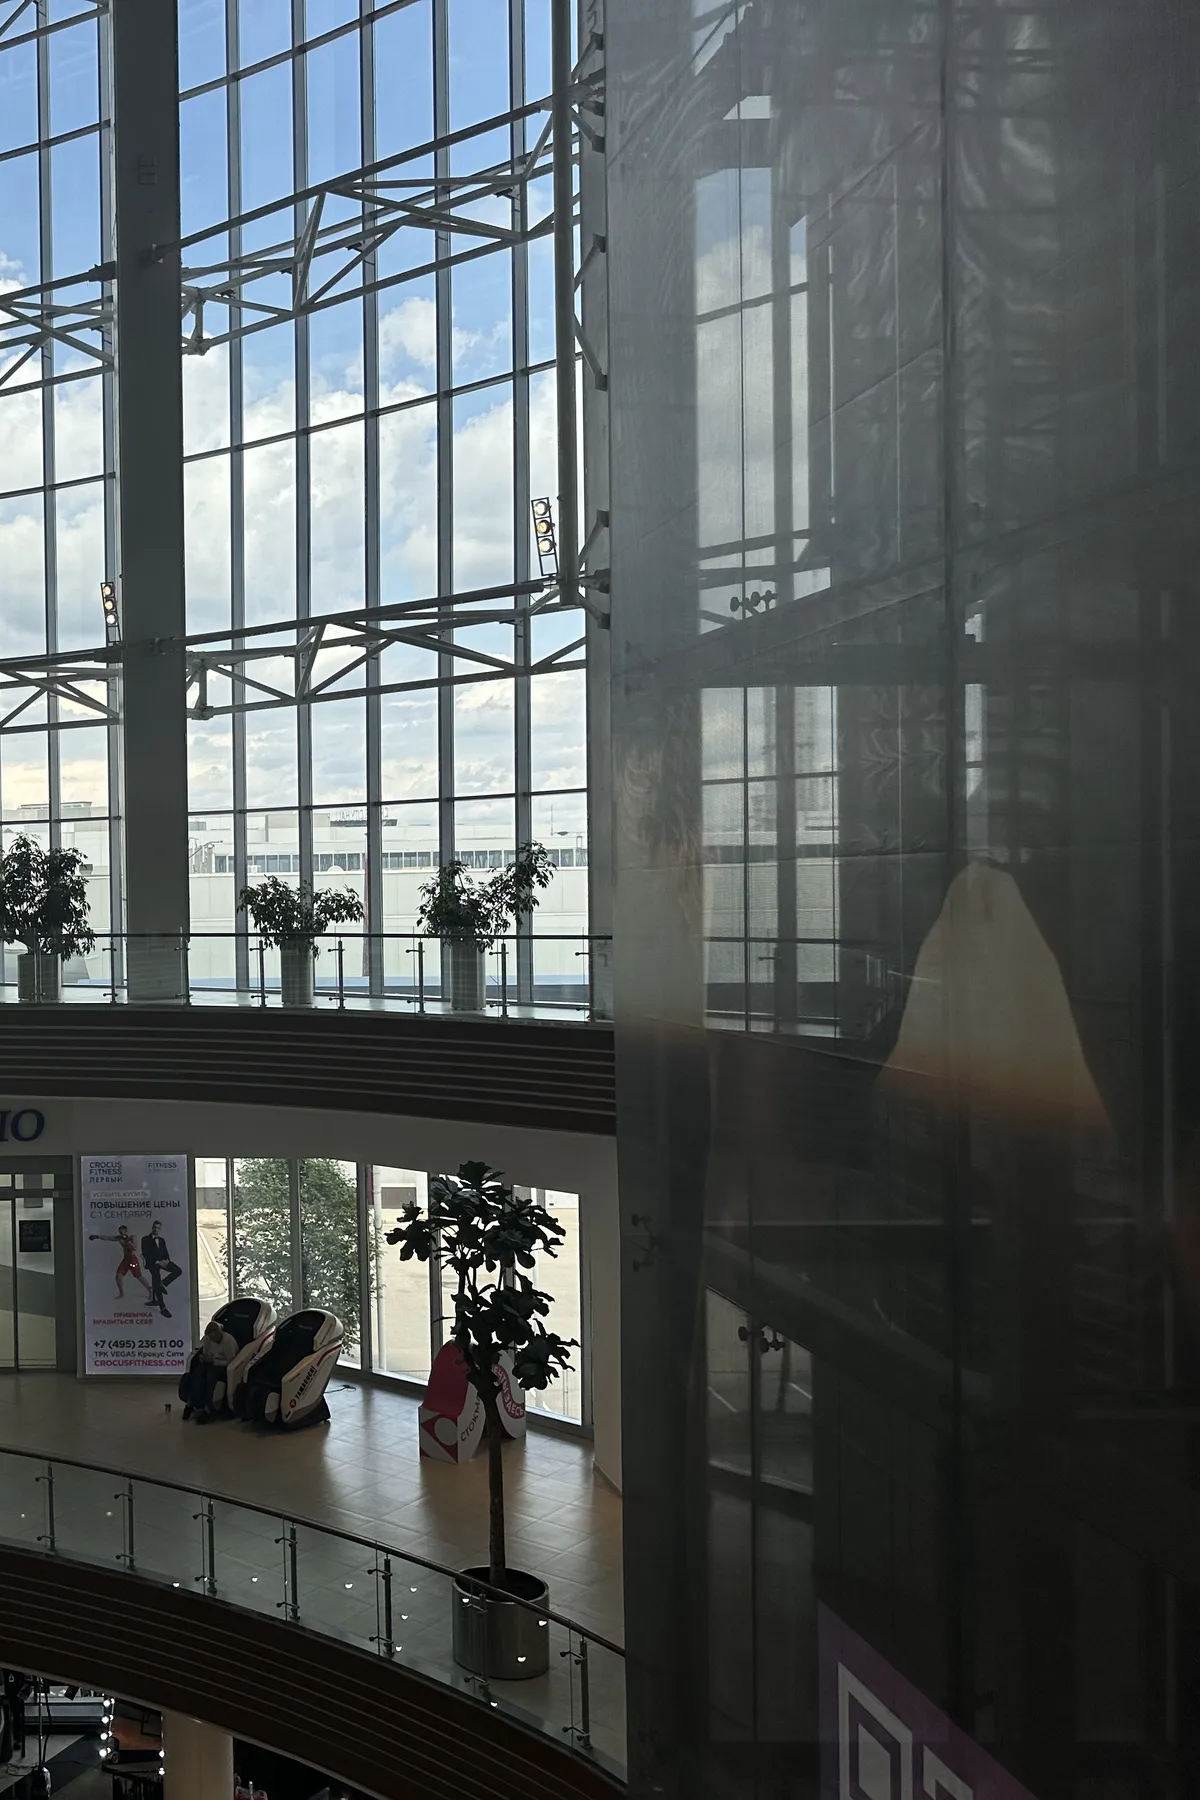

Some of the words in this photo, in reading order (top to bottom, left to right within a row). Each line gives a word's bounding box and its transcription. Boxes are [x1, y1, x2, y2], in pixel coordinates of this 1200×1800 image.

[90, 1201, 151, 1209] ПОВЫШЕНИЕ
[153, 1200, 180, 1209] ЦЕНЫ
[90, 1211, 97, 1219] С
[104, 1210, 152, 1219] СЕНТЯБРЯ
[93, 1340, 106, 1348] +7
[108, 1339, 136, 1350] (495)
[138, 1340, 156, 1348] 236
[158, 1340, 167, 1348] 11
[169, 1340, 184, 1348] 00
[137, 1351, 164, 1359] Крокус
[94, 1359, 184, 1367] CROCUSFITNESS.COM
[294, 1366, 316, 1400] YAMAGUCHI
